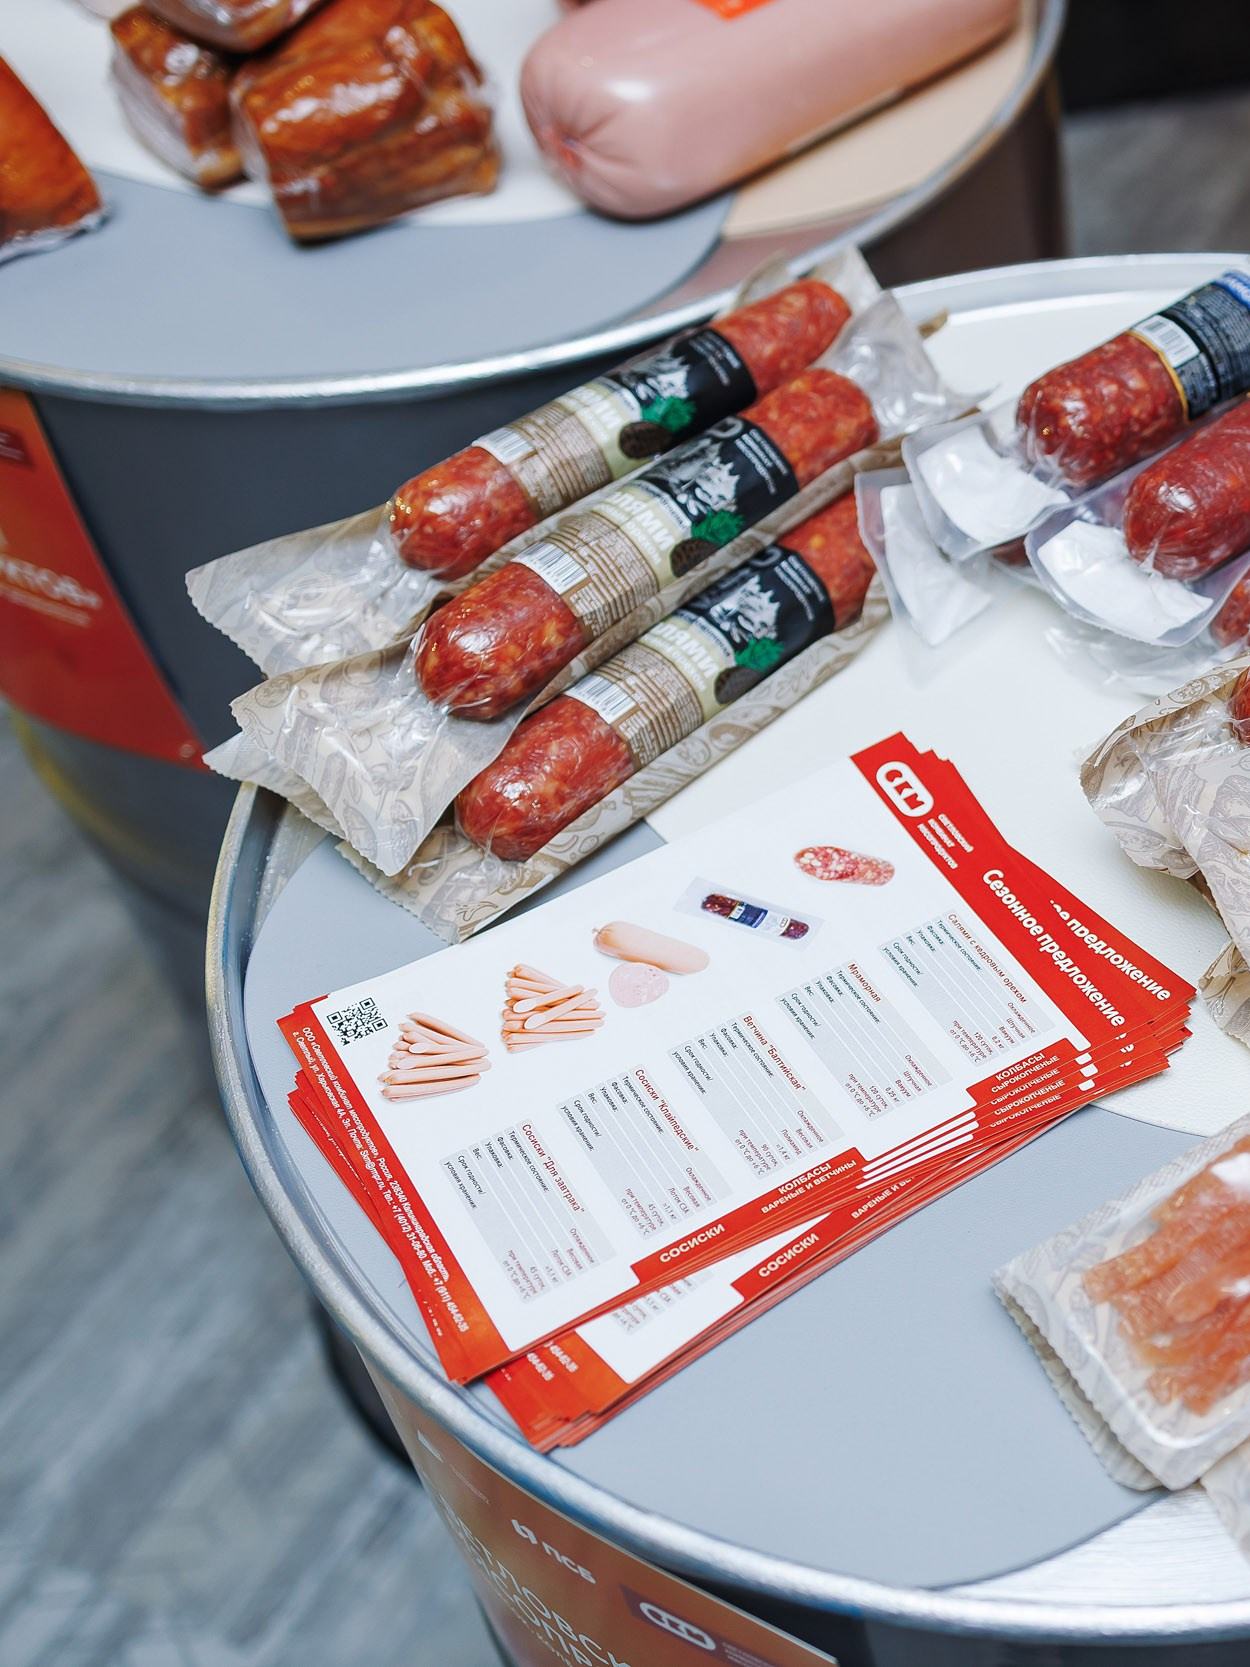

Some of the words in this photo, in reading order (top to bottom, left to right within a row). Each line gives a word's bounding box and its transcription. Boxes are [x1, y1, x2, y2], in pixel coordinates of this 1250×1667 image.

[882, 765, 926, 813] СКМ
[936, 919, 961, 948] Термическое
[959, 947, 982, 972] состояние:
[947, 913, 971, 940] Салями
[973, 944, 1005, 978] кедровым
[1003, 977, 1027, 1004] орехом
[982, 868, 1045, 936] Сезонное
[1035, 933, 1125, 1028] предложение
[804, 985, 814, 997] Вес:
[815, 980, 835, 1003] Упаковка:
[826, 975, 844, 996] Фасовка:
[836, 970, 861, 1000] Термическое
[859, 999, 881, 1024] состояние:
[847, 963, 881, 1003] Мраморная
[1007, 1002, 1035, 1034] Охлажденное
[697, 1038, 708, 1050] Вес:
[709, 1032, 729, 1057] Упаковка:
[720, 1027, 738, 1049] Фасовка:
[731, 1022, 755, 1053] Термическое
[753, 1052, 774, 1078] состояние:
[743, 1015, 768, 1046] Ветчина
[766, 1044, 805, 1091] "Балтийская"
[672, 1051, 689, 1071] условия
[686, 1070, 707, 1094] хранения:
[683, 1045, 696, 1060] Срок
[692, 1058, 713, 1081] годности/
[902, 1070, 922, 1092] Штучная
[904, 1054, 932, 1087] Охлажденное
[991, 1054, 1059, 1093] СЫРОКОПЧЕНЫЕ
[995, 1048, 1045, 1082] КОЛБАСЫ
[587, 1092, 598, 1104] Вес:
[599, 1086, 619, 1112] Упаковка:
[611, 1081, 629, 1104] Фасовка:
[622, 1075, 646, 1108] Термическое
[643, 1107, 664, 1134] состояние:
[895, 1079, 911, 1098] Вакуум
[994, 1079, 1065, 1116] СЫРОКОПЧЕНЫЕ
[300, 1025, 317, 1043] ООО
[374, 1156, 395, 1182] Россия,
[387, 1179, 408, 1204] 238340
[560, 1105, 578, 1127] условия
[574, 1125, 595, 1151] хранения:
[573, 1099, 586, 1115] Срок
[582, 1113, 602, 1137] годности/
[635, 1069, 660, 1101] Сосиски
[657, 1099, 698, 1152] "Клайпедские"
[797, 1109, 824, 1143] Охлажденное
[780, 1128, 802, 1155] Полиамид
[795, 1128, 813, 1149] Весовая
[508, 1130, 532, 1165] Термическое
[529, 1165, 549, 1193] состояние:
[521, 1123, 546, 1158] Сосиски
[542, 1156, 559, 1177] "Для
[554, 1176, 584, 1213] завтрака"
[778, 1159, 831, 1195] КОЛБАСЫ
[668, 1187, 681, 1203] Лоток
[683, 1186, 700, 1208] Весовая
[685, 1167, 711, 1201] Охлажденное
[761, 1186, 805, 1214] ВАРЕНЫЕ
[812, 1159, 857, 1186] ВЕТЧИНЫ
[394, 1211, 413, 1234] (4012)
[850, 1189, 890, 1220] ВАРЕНЫЕ
[566, 1248, 583, 1270] Весовая
[659, 1224, 725, 1263] СОСИСКИ
[758, 1233, 819, 1277] СОСИСКИ
[542, 1541, 597, 1585] ПСБ
